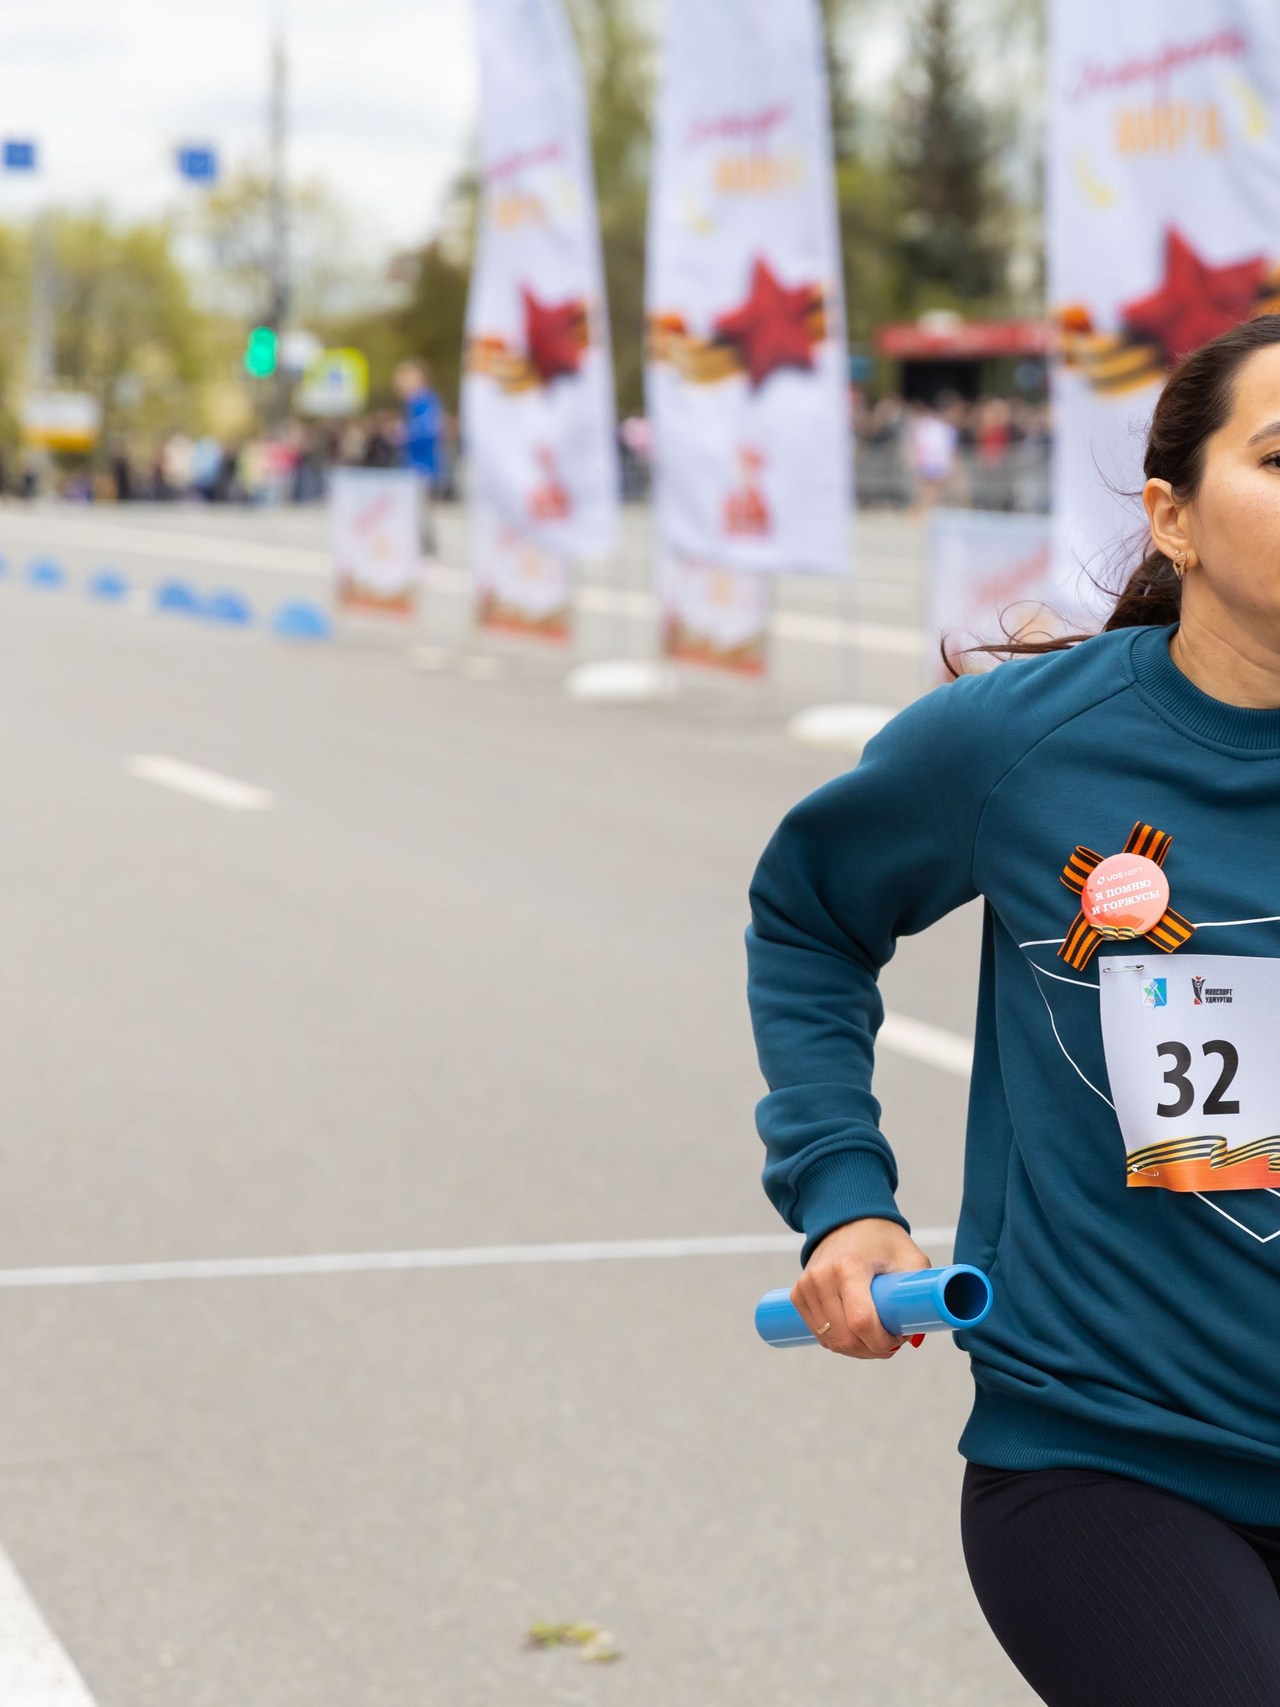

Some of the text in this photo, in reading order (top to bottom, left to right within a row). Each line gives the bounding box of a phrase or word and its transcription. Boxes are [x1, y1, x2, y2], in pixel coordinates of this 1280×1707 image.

[1091, 890, 1160, 915] И ГОРЖУСЬ!
[1095, 879, 1152, 901] Я ПОМНЮ
[1156, 1040, 1240, 1118] 32
